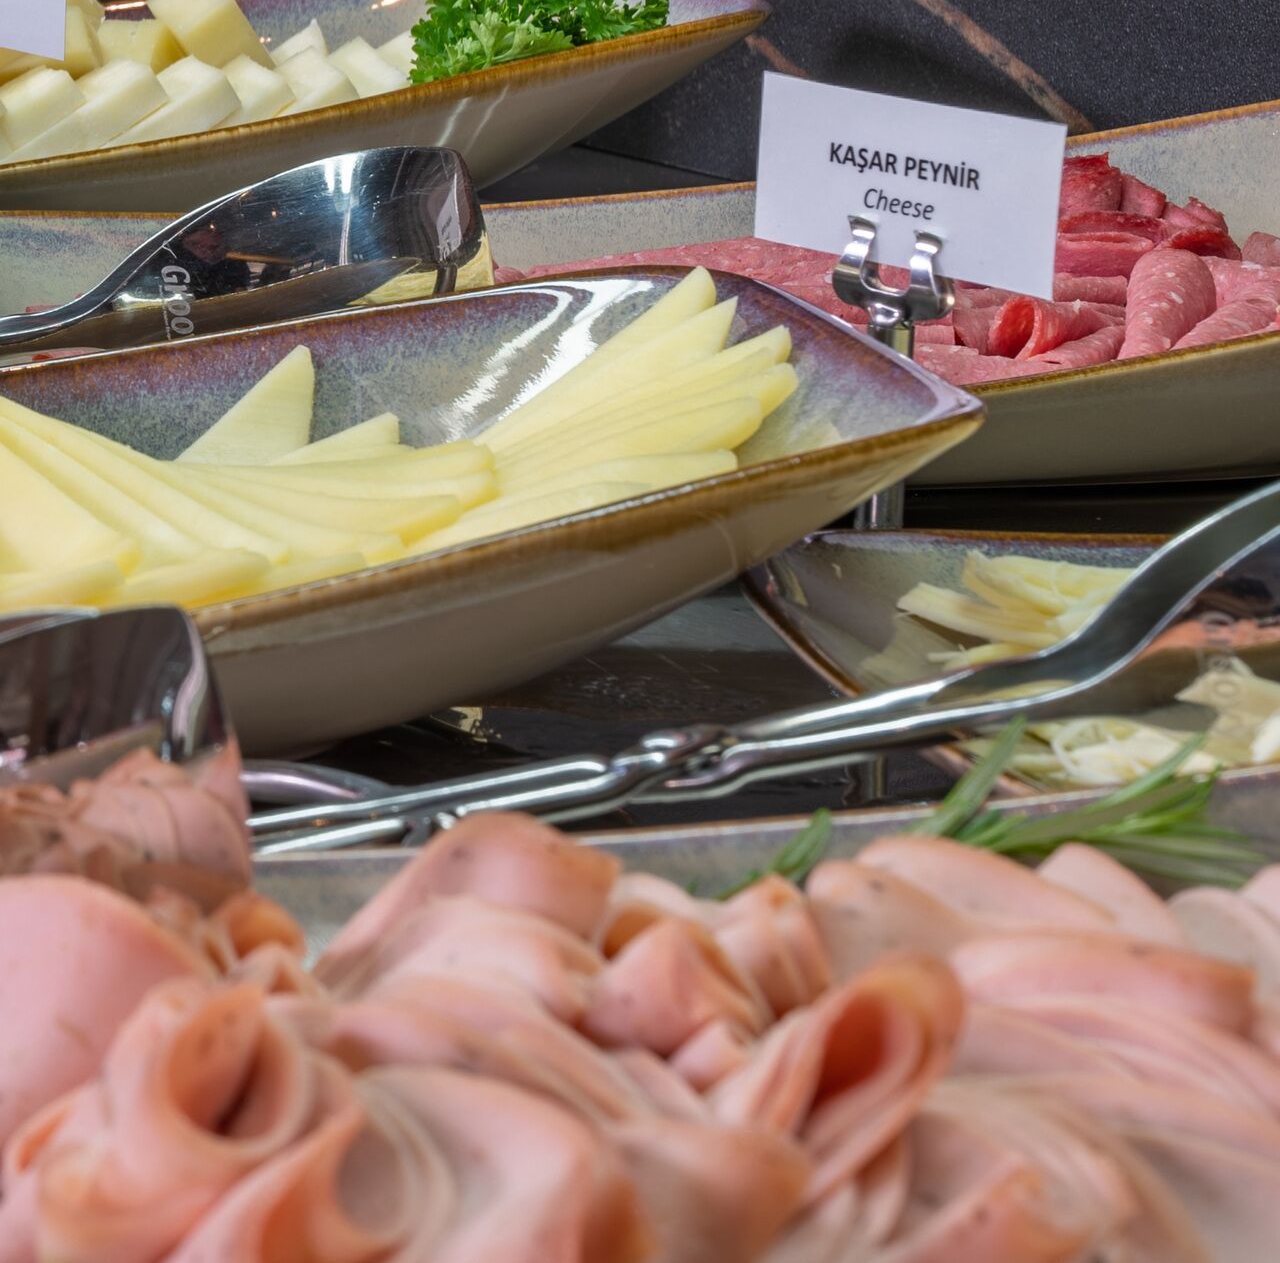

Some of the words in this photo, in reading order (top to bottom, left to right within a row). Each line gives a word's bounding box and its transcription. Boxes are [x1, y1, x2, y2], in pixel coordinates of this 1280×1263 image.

[829, 142, 898, 174] KAŞAR
[904, 156, 980, 190] PEYNİR
[863, 188, 935, 220] Cheese
